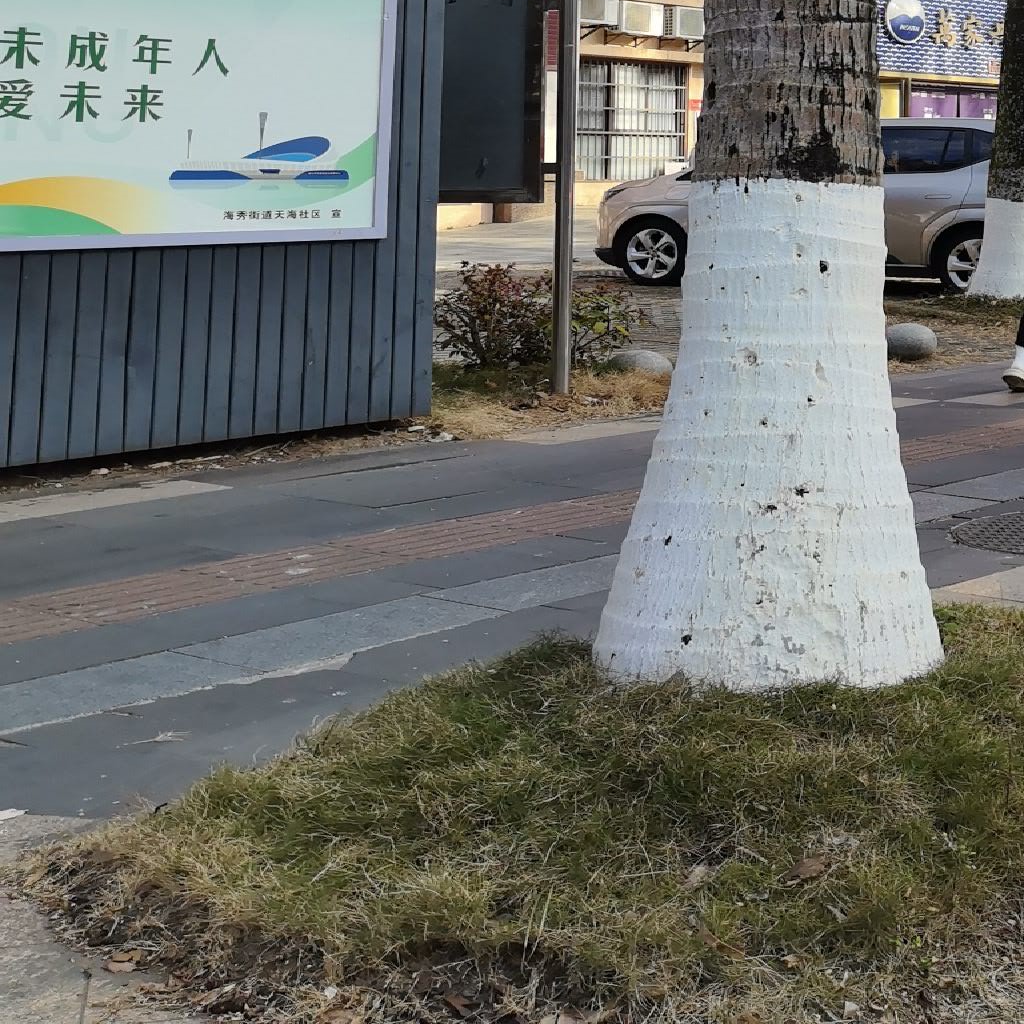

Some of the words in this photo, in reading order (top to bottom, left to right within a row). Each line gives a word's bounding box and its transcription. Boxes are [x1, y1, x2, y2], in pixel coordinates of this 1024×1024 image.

[0, 27, 230, 77] 未成年人
[0, 78, 165, 124] 爱未来
[223, 208, 321, 220] 海秀街道天海社区
[331, 208, 342, 219] 宣
